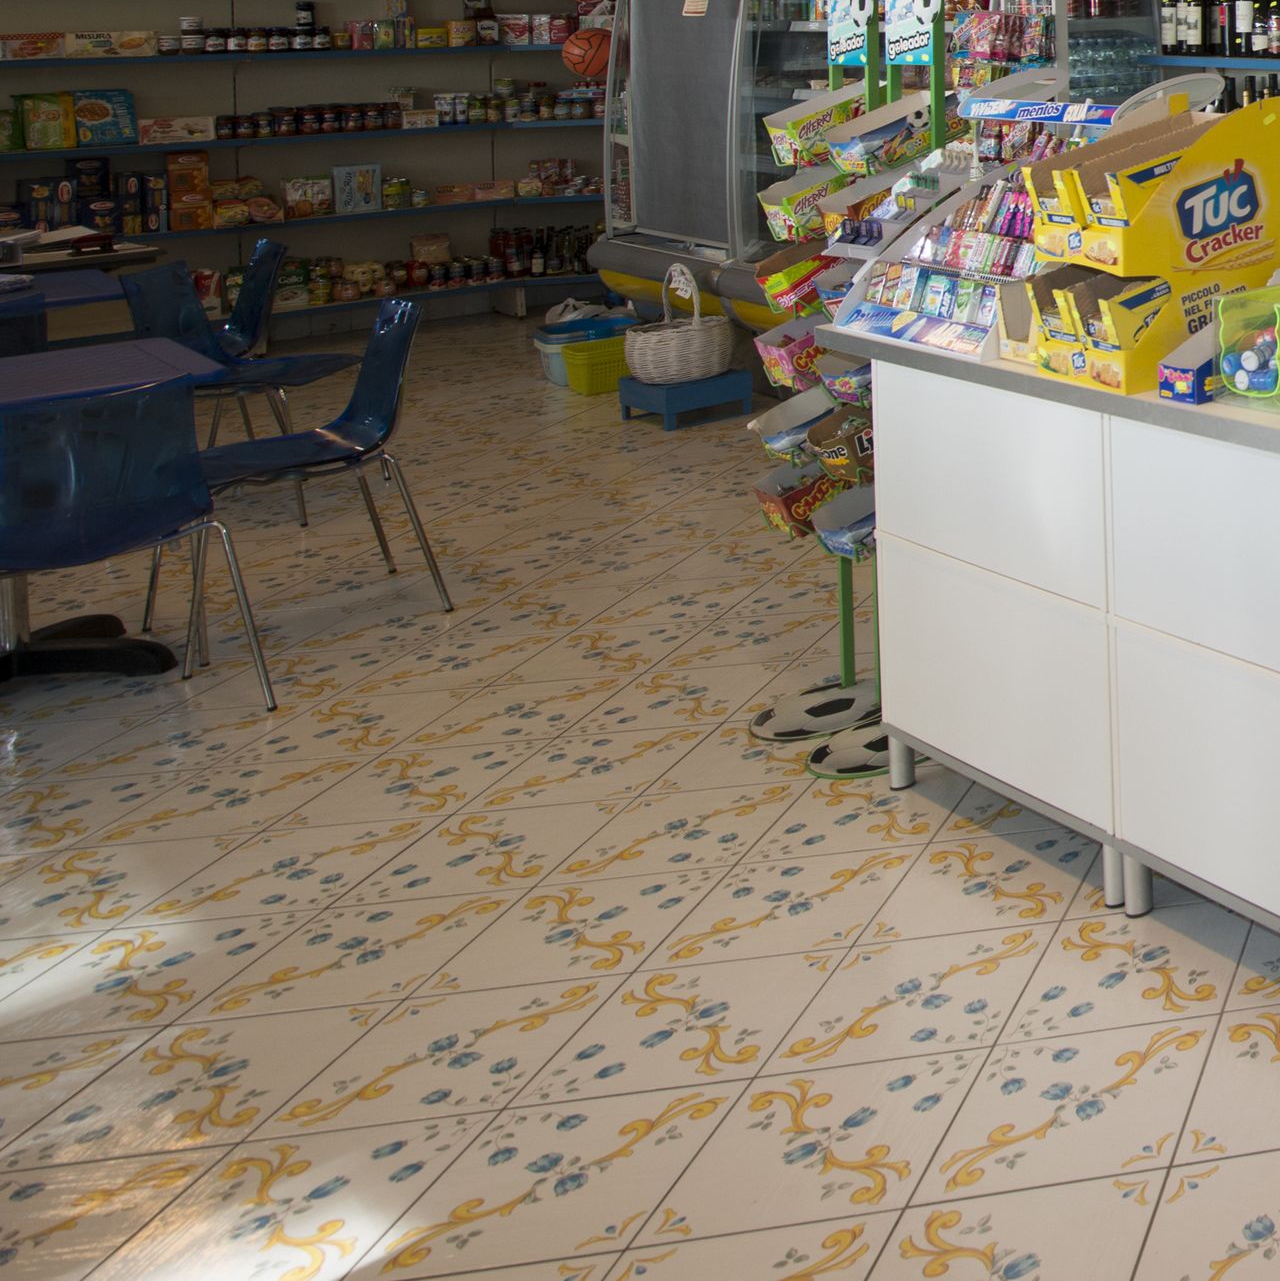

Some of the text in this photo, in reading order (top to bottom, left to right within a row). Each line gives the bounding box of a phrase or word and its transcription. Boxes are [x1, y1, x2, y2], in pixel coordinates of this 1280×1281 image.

[75, 33, 112, 41] MISURA
[888, 32, 930, 61] goleador
[1017, 102, 1062, 118] mentos
[799, 109, 834, 139] CHERRY
[794, 182, 830, 215] CHERRY
[1184, 184, 1252, 235] TUC
[1185, 223, 1264, 264] Cracker
[279, 275, 304, 285] Gallo
[1181, 283, 1222, 305] PICCOLO
[1184, 302, 1204, 318] NEL
